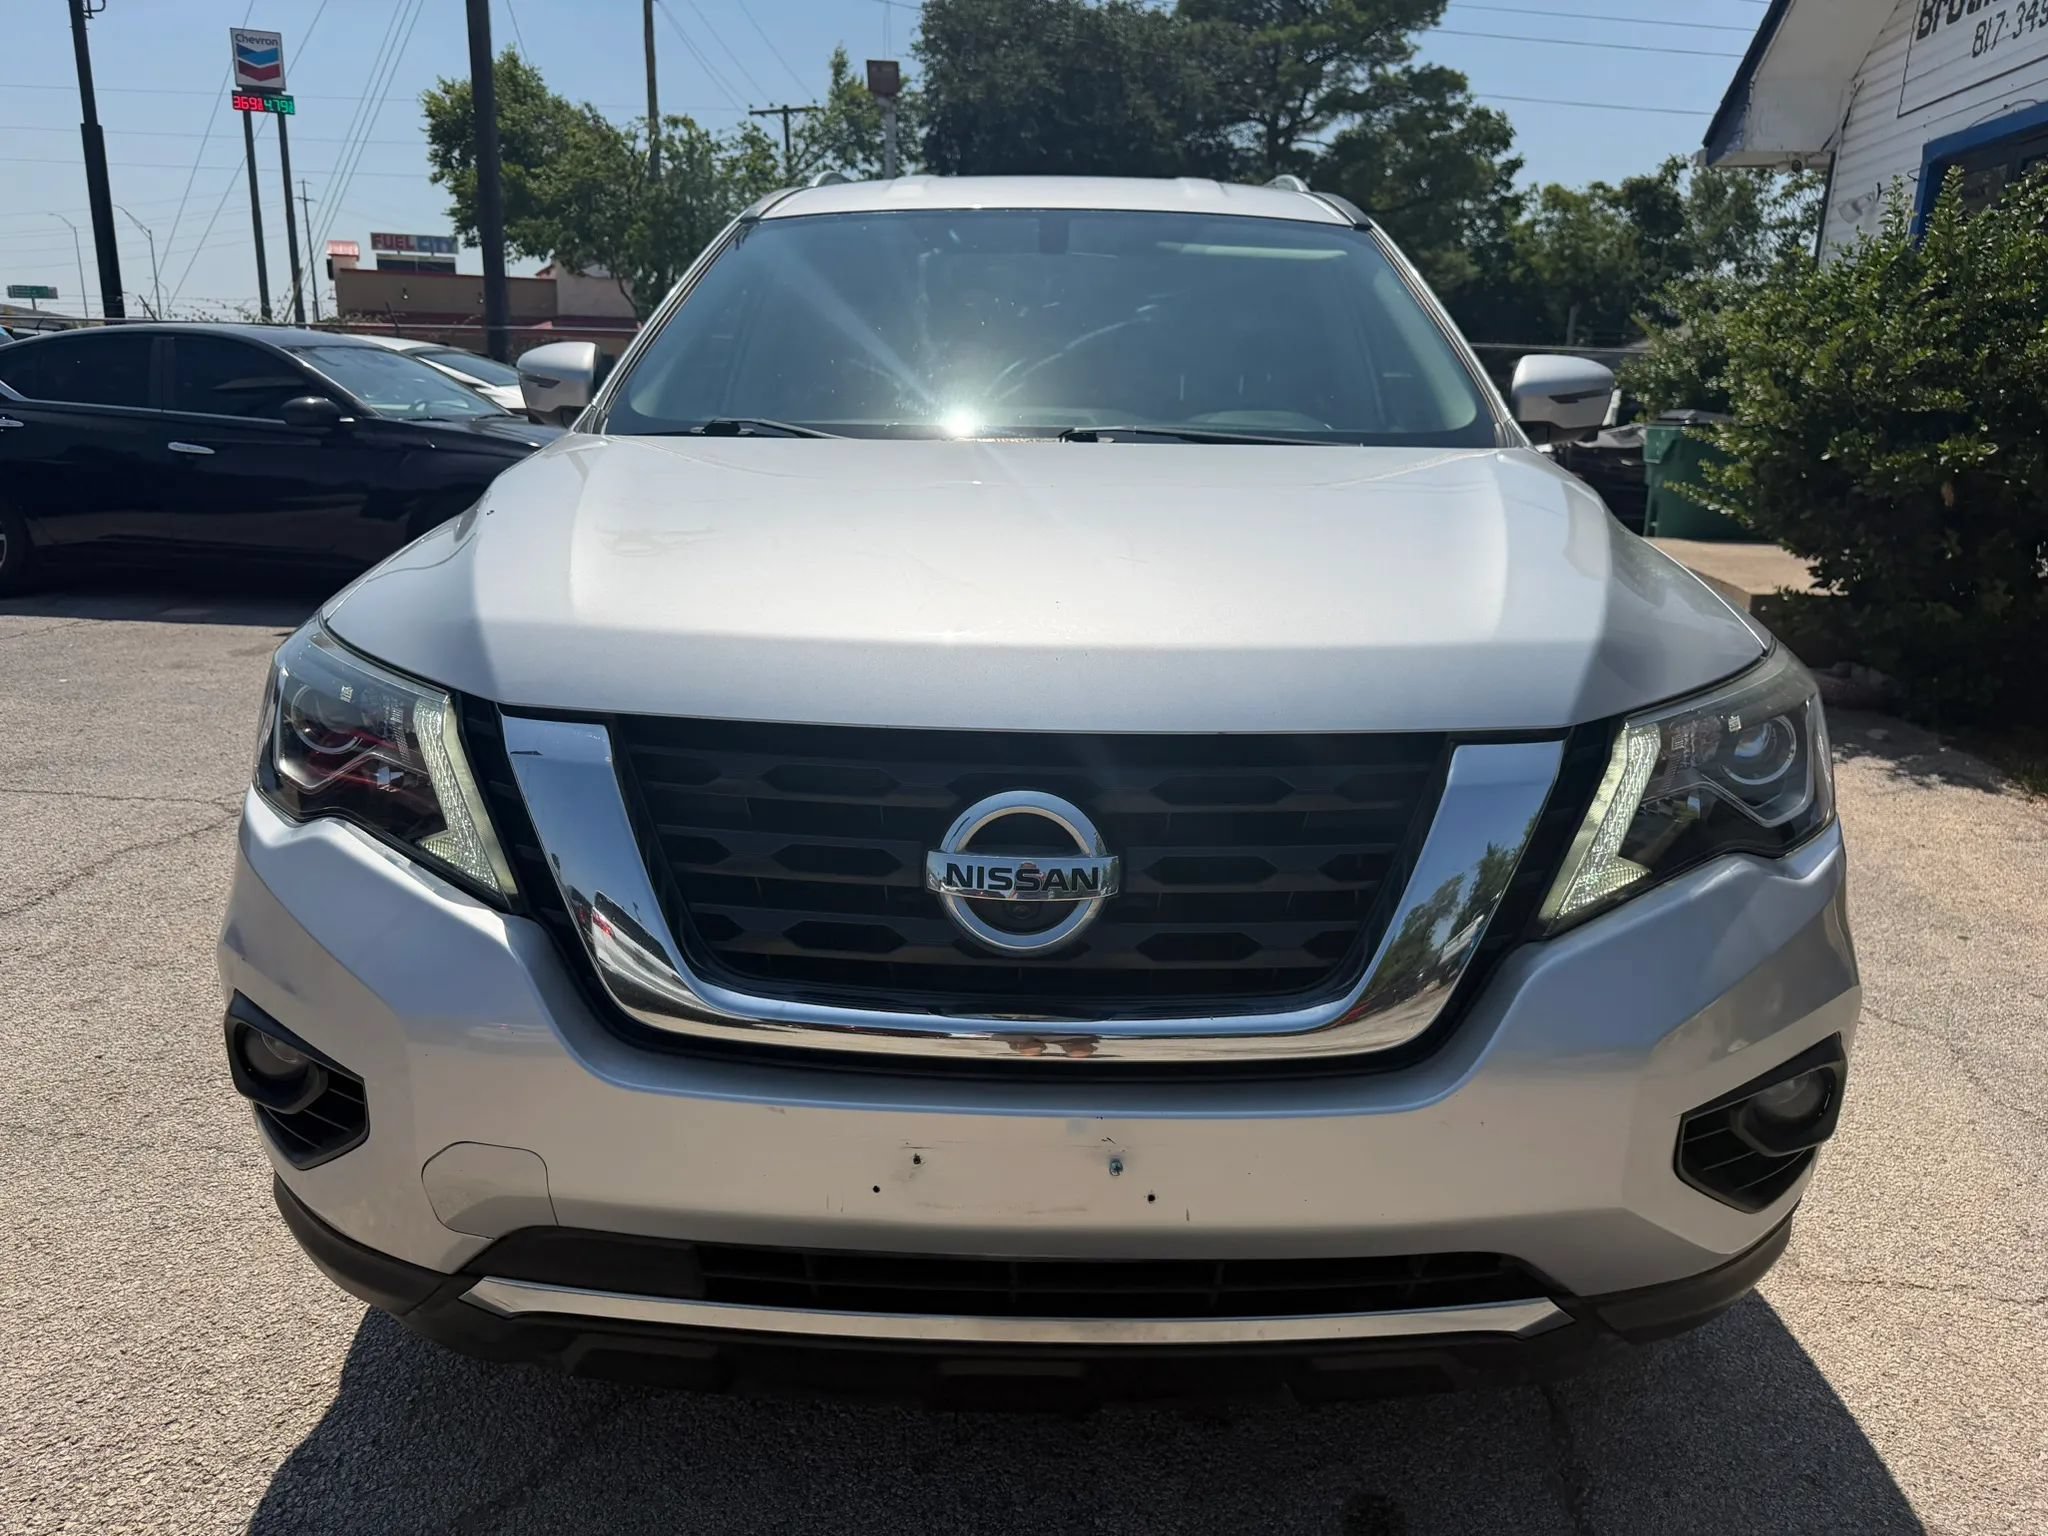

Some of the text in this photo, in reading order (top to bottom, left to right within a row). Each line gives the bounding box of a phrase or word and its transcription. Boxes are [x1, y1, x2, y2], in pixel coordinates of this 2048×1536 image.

[235, 33, 279, 46] Chevron
[373, 234, 415, 251] FUEL
[946, 862, 1099, 891] NISSAN
